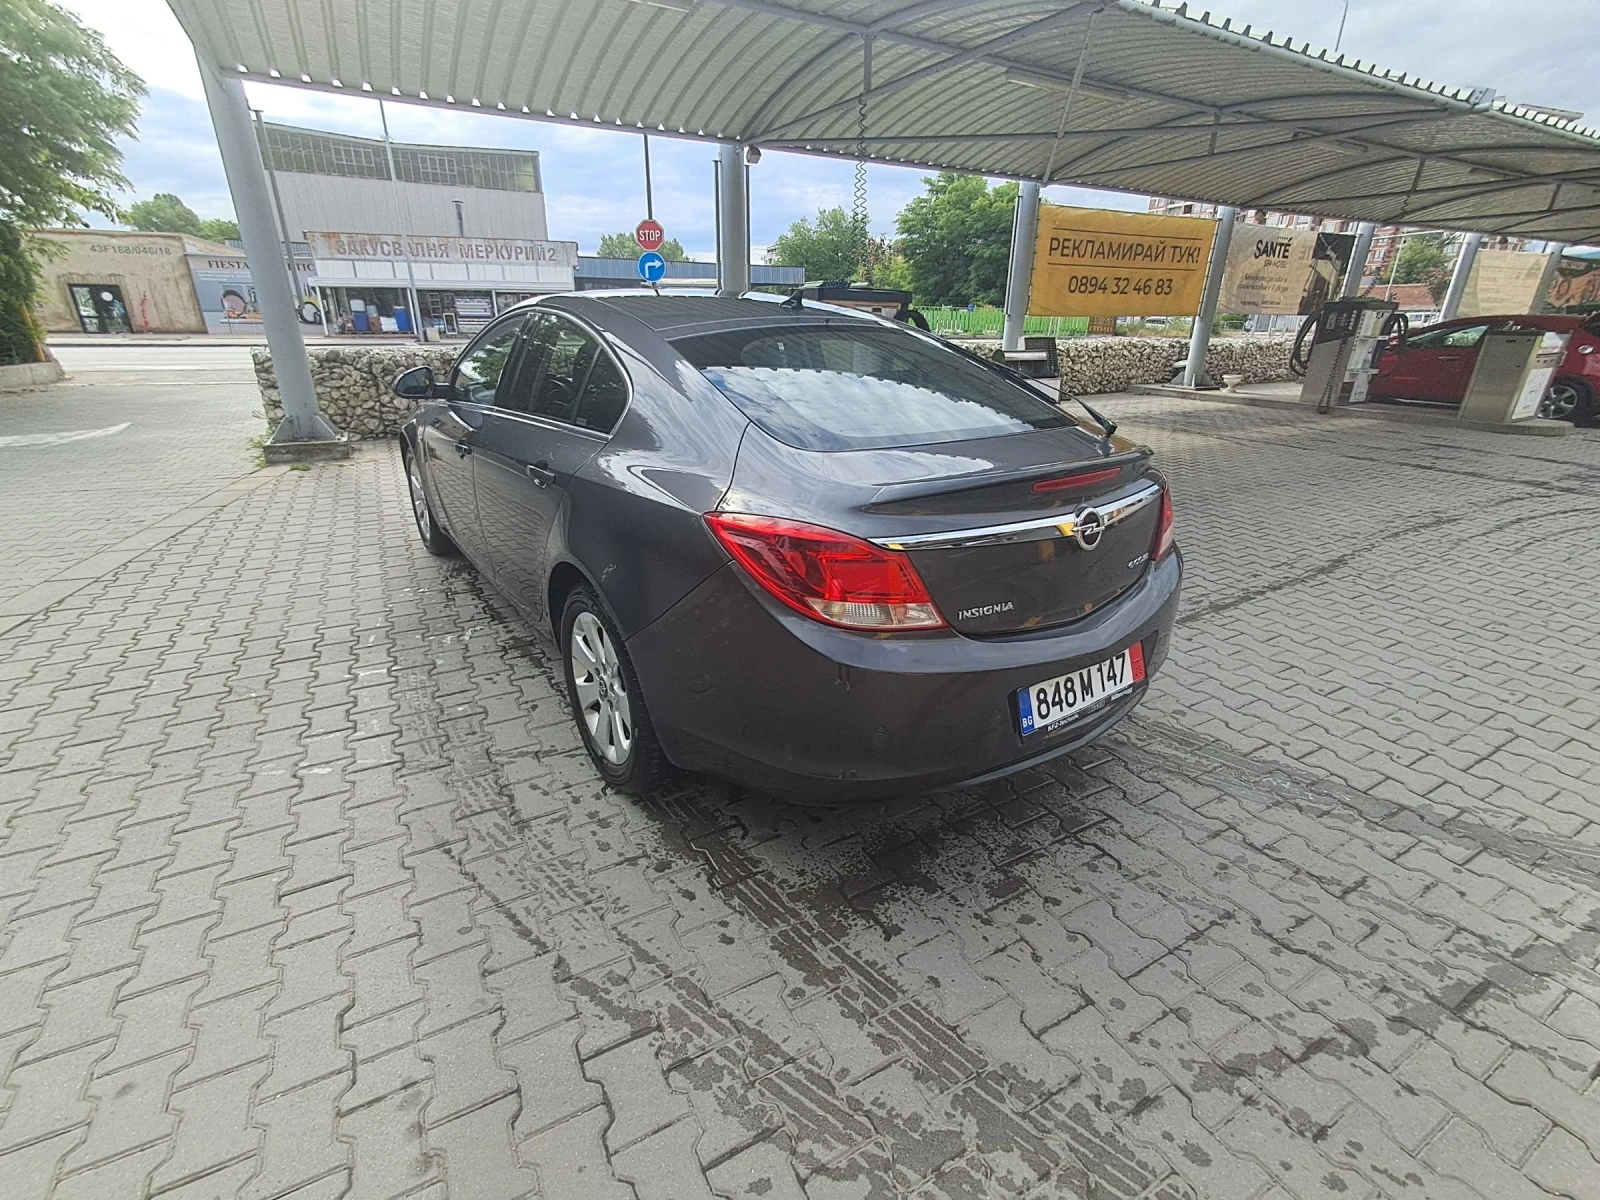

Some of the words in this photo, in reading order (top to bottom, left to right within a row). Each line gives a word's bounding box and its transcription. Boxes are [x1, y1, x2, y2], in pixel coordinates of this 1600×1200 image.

[639, 229, 661, 241] STOP
[1048, 237, 1166, 263] РЕКЛАМИРАЙ
[1170, 245, 1201, 264] ТУК!
[1254, 237, 1292, 259] SANTÉ
[208, 260, 250, 269] FIESTA
[1068, 275, 1108, 294] 0894
[1111, 277, 1130, 295] 32
[1132, 278, 1153, 295] 46
[1155, 278, 1173, 296] 83
[958, 601, 1015, 620] INSIGNIA
[1036, 677, 1077, 719] 848
[1079, 668, 1094, 702] M
[1097, 652, 1126, 692] 147
[1022, 715, 1033, 728] BG
